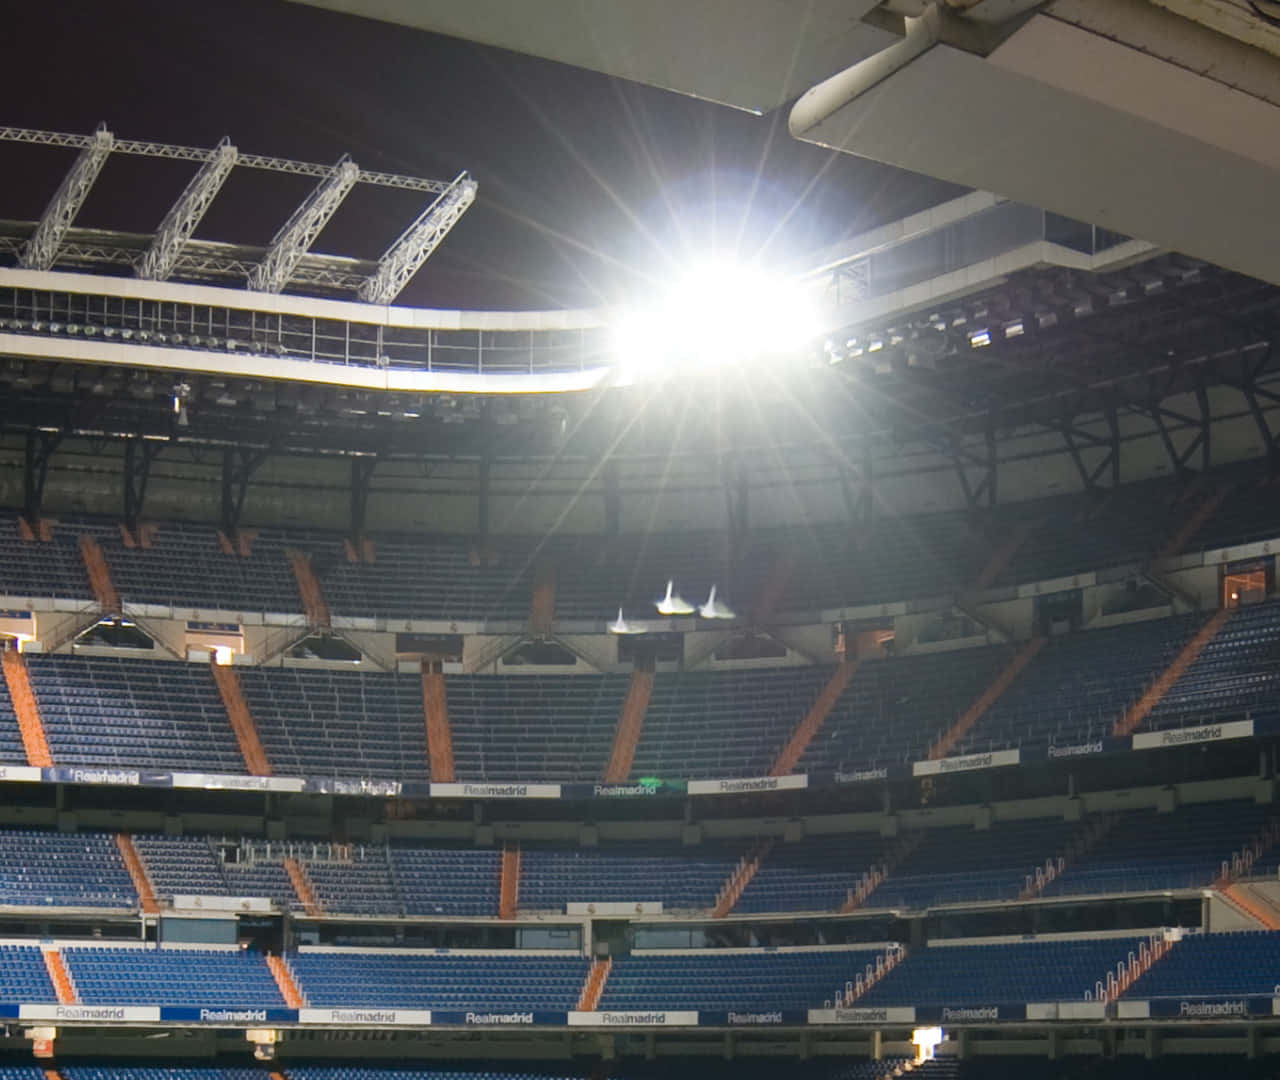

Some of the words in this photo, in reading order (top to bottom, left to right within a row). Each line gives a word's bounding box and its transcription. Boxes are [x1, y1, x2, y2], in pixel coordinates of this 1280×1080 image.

[1163, 726, 1222, 743] Realmadrid
[464, 784, 527, 796] Realmadrid
[593, 784, 656, 796] Realmadrid
[720, 778, 777, 792] Realmadrid
[56, 1007, 124, 1018] Realmadrid
[200, 1009, 266, 1021] Realmadrid
[331, 1010, 396, 1022] Realmadrid
[465, 1012, 533, 1024] Realmadrid
[602, 1013, 666, 1024] Realmadrid
[728, 1012, 782, 1024] Realmadrid
